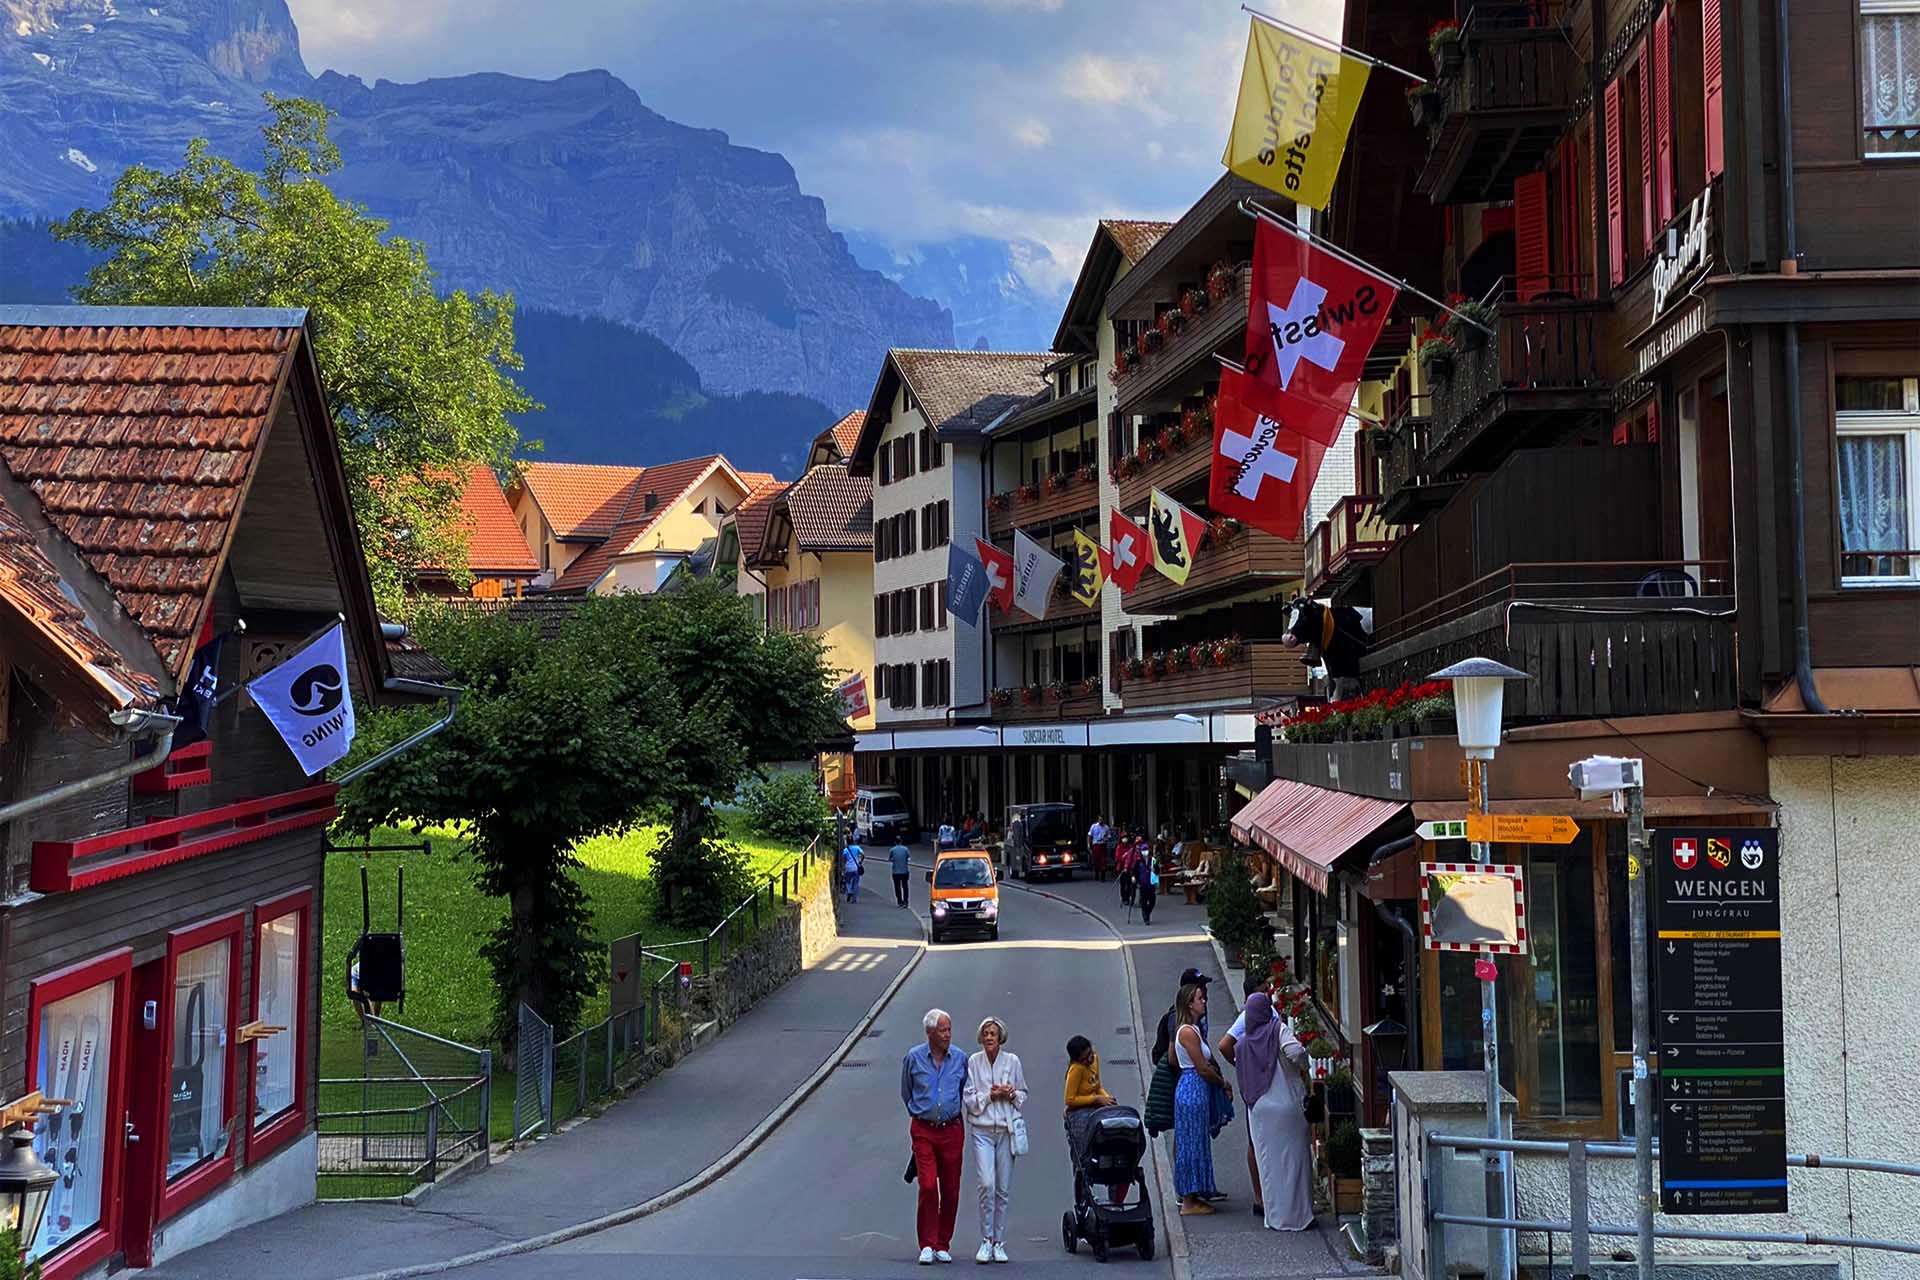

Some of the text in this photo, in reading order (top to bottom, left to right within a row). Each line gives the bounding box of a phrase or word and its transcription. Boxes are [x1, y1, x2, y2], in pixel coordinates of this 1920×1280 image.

[1023, 729, 1065, 744] SUNSTAR HOTEL
[1675, 880, 1765, 896] WENGEN
[1692, 909, 1750, 919] JUNGFRAU
[60, 1040, 70, 1072] MACH
[82, 1040, 92, 1071] MACH
